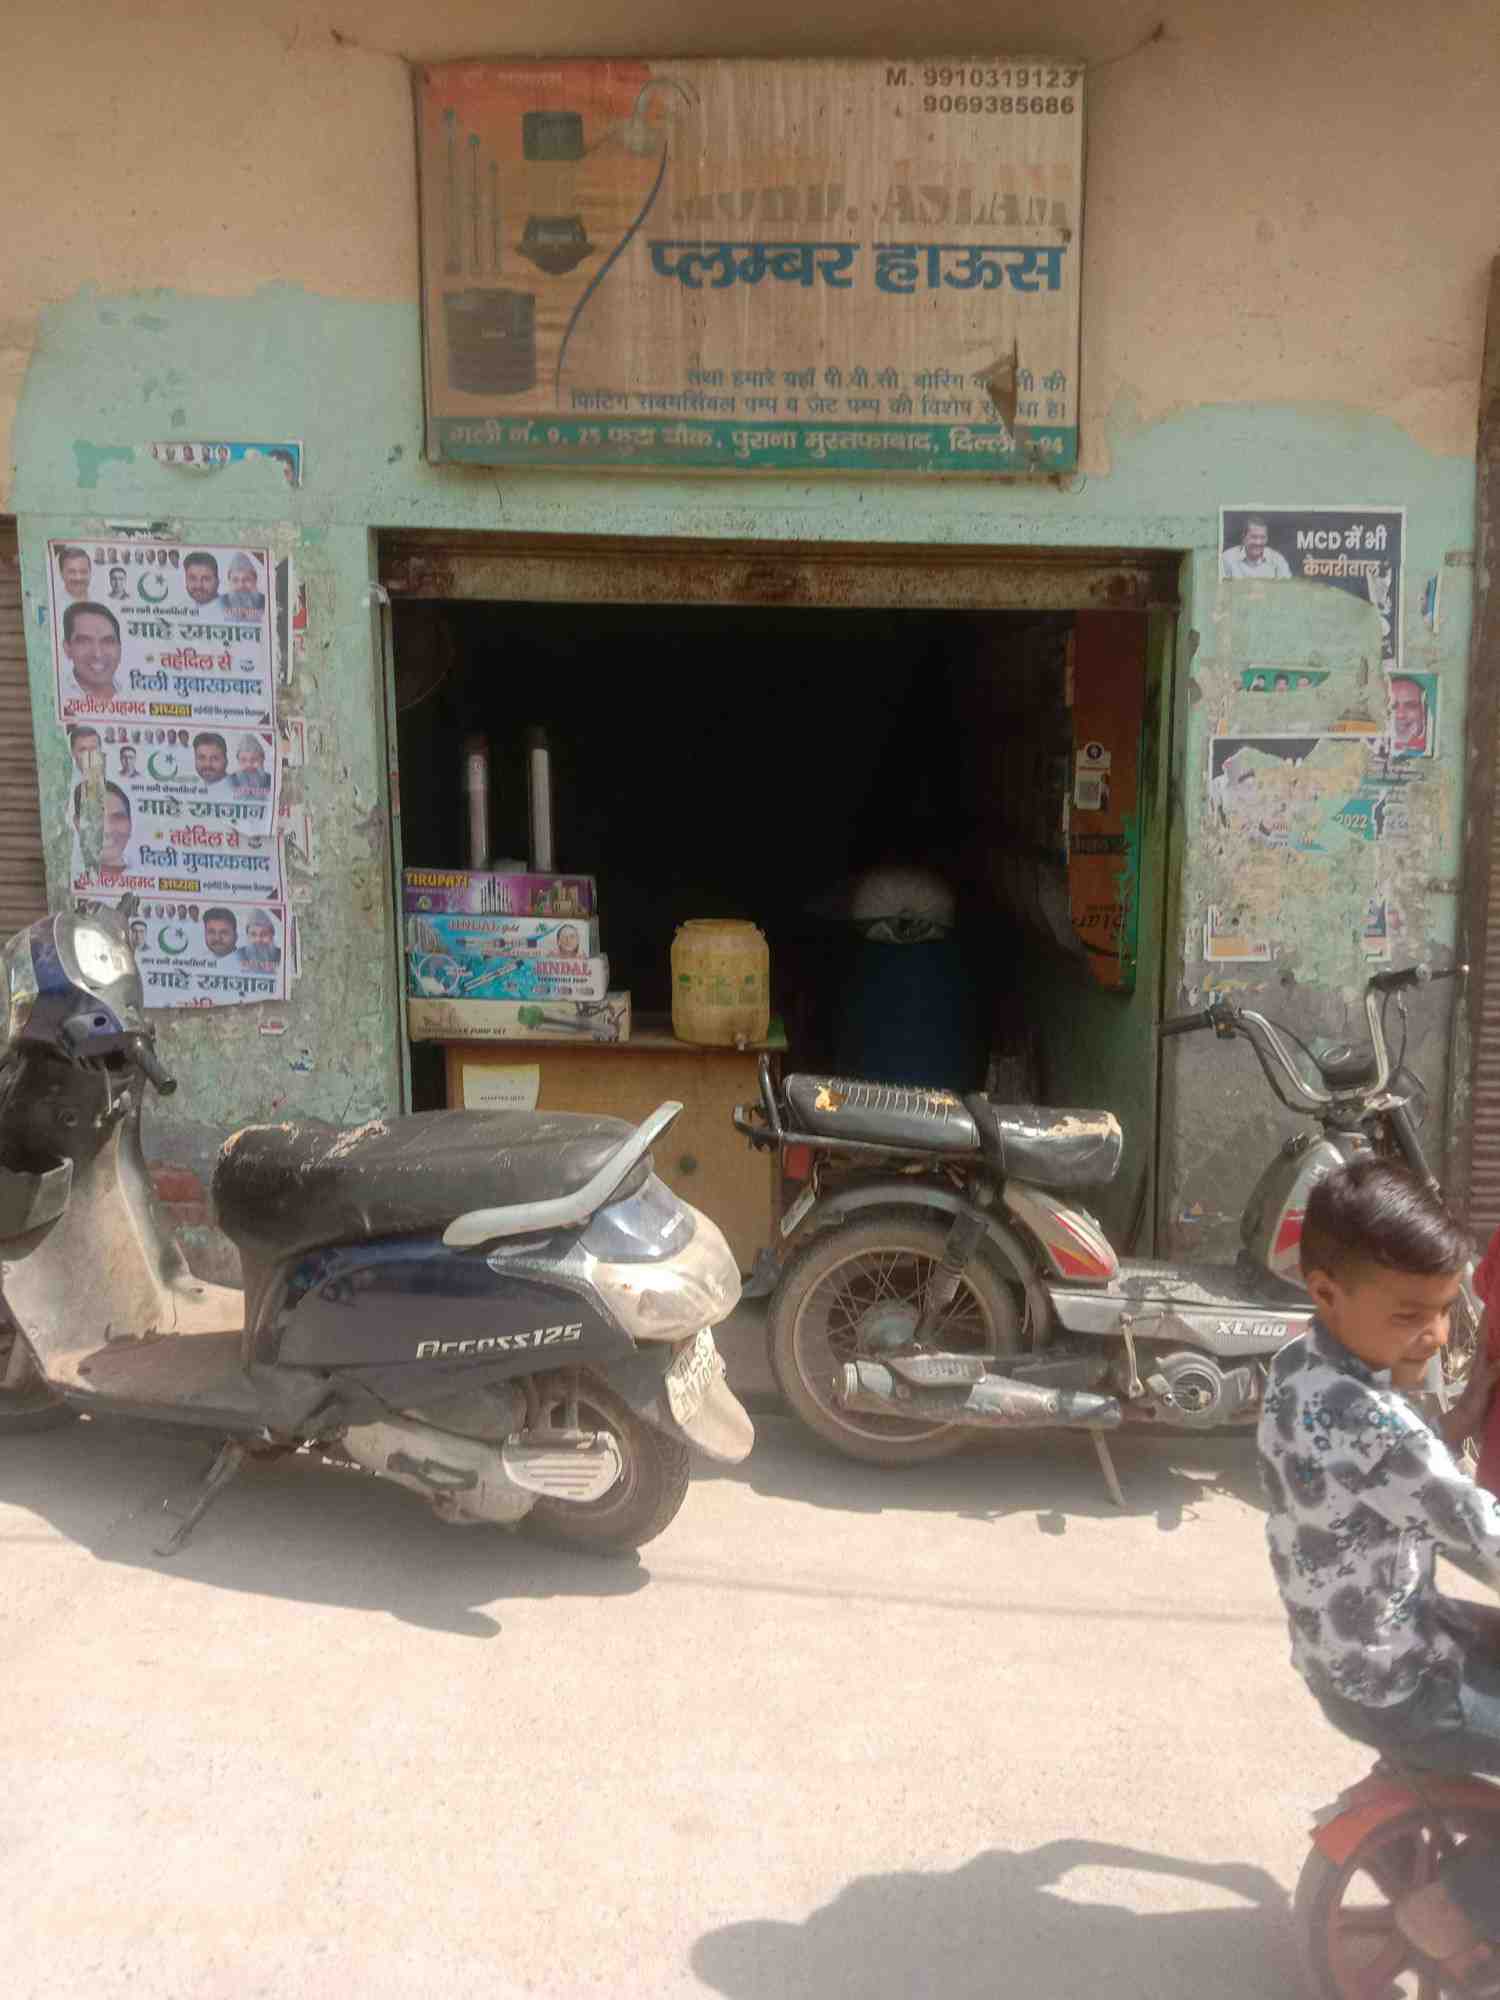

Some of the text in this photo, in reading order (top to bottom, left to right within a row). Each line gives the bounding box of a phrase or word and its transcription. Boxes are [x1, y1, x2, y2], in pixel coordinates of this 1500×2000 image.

[885, 67, 1077, 89] M. 9910319123
[923, 95, 1075, 115] 9069385686
[647, 237, 1067, 294] प्लम्बर हाऊस
[731, 430, 799, 459] पुराना
[1296, 523, 1388, 552] MCD में भी
[1303, 552, 1381, 577] केजरीवाल
[127, 617, 173, 641] माहे
[160, 647, 214, 671] तहेदिल
[218, 649, 232, 671] से
[172, 674, 263, 697] मुबारकबाद
[137, 795, 184, 817] माहे
[1334, 813, 1369, 829] 2022
[170, 823, 224, 848] तहेदिल
[225, 827, 240, 848] से
[181, 851, 271, 873] मुबारकबाद
[147, 967, 192, 990] माहे
